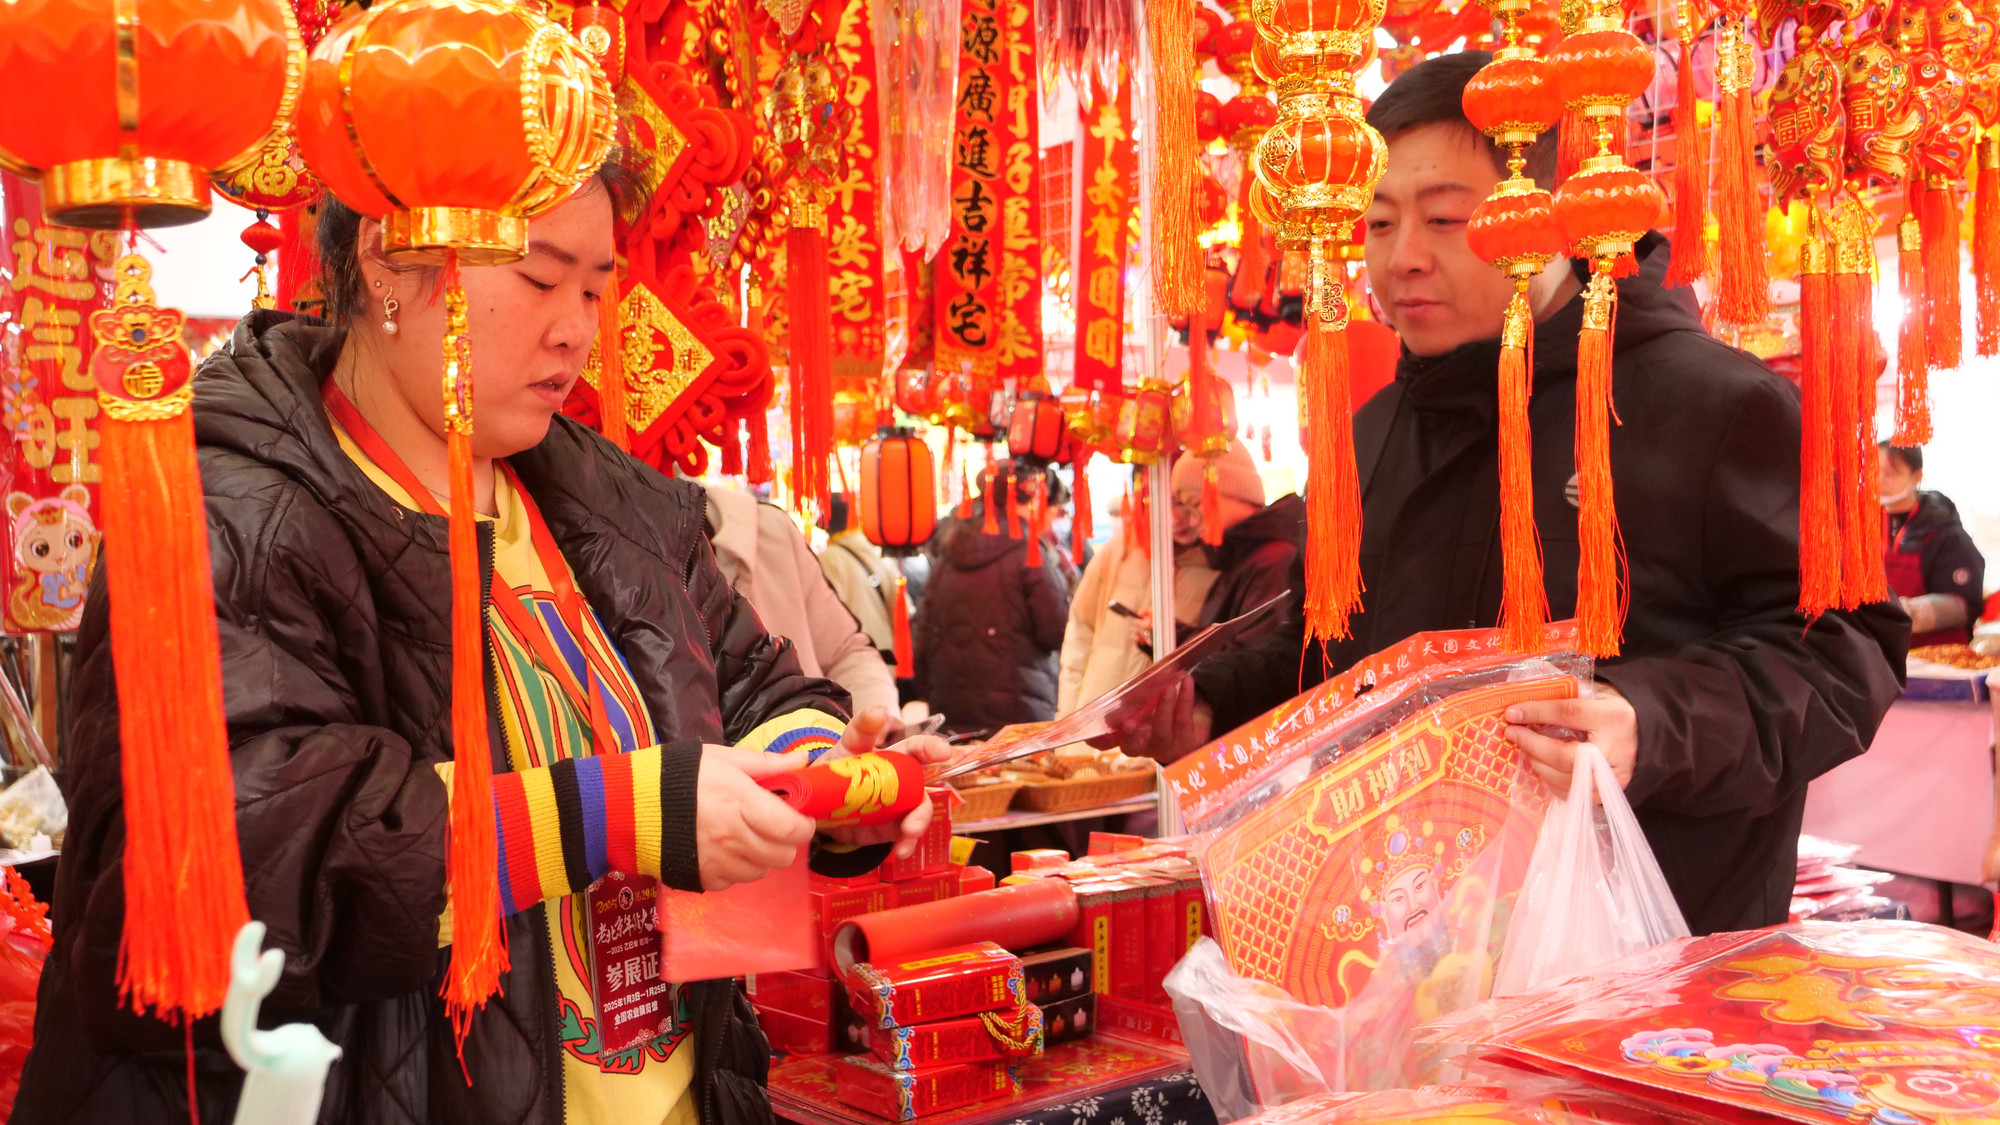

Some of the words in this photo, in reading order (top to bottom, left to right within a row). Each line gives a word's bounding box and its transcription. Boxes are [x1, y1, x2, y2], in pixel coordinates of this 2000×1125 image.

[951, 0, 999, 347] 源廣進吉祥宅
[10, 217, 102, 484] 运气旺
[1329, 738, 1432, 823] 財神到
[606, 951, 660, 993] 参展证
[614, 1000, 659, 1026] 全国农业展览馆
